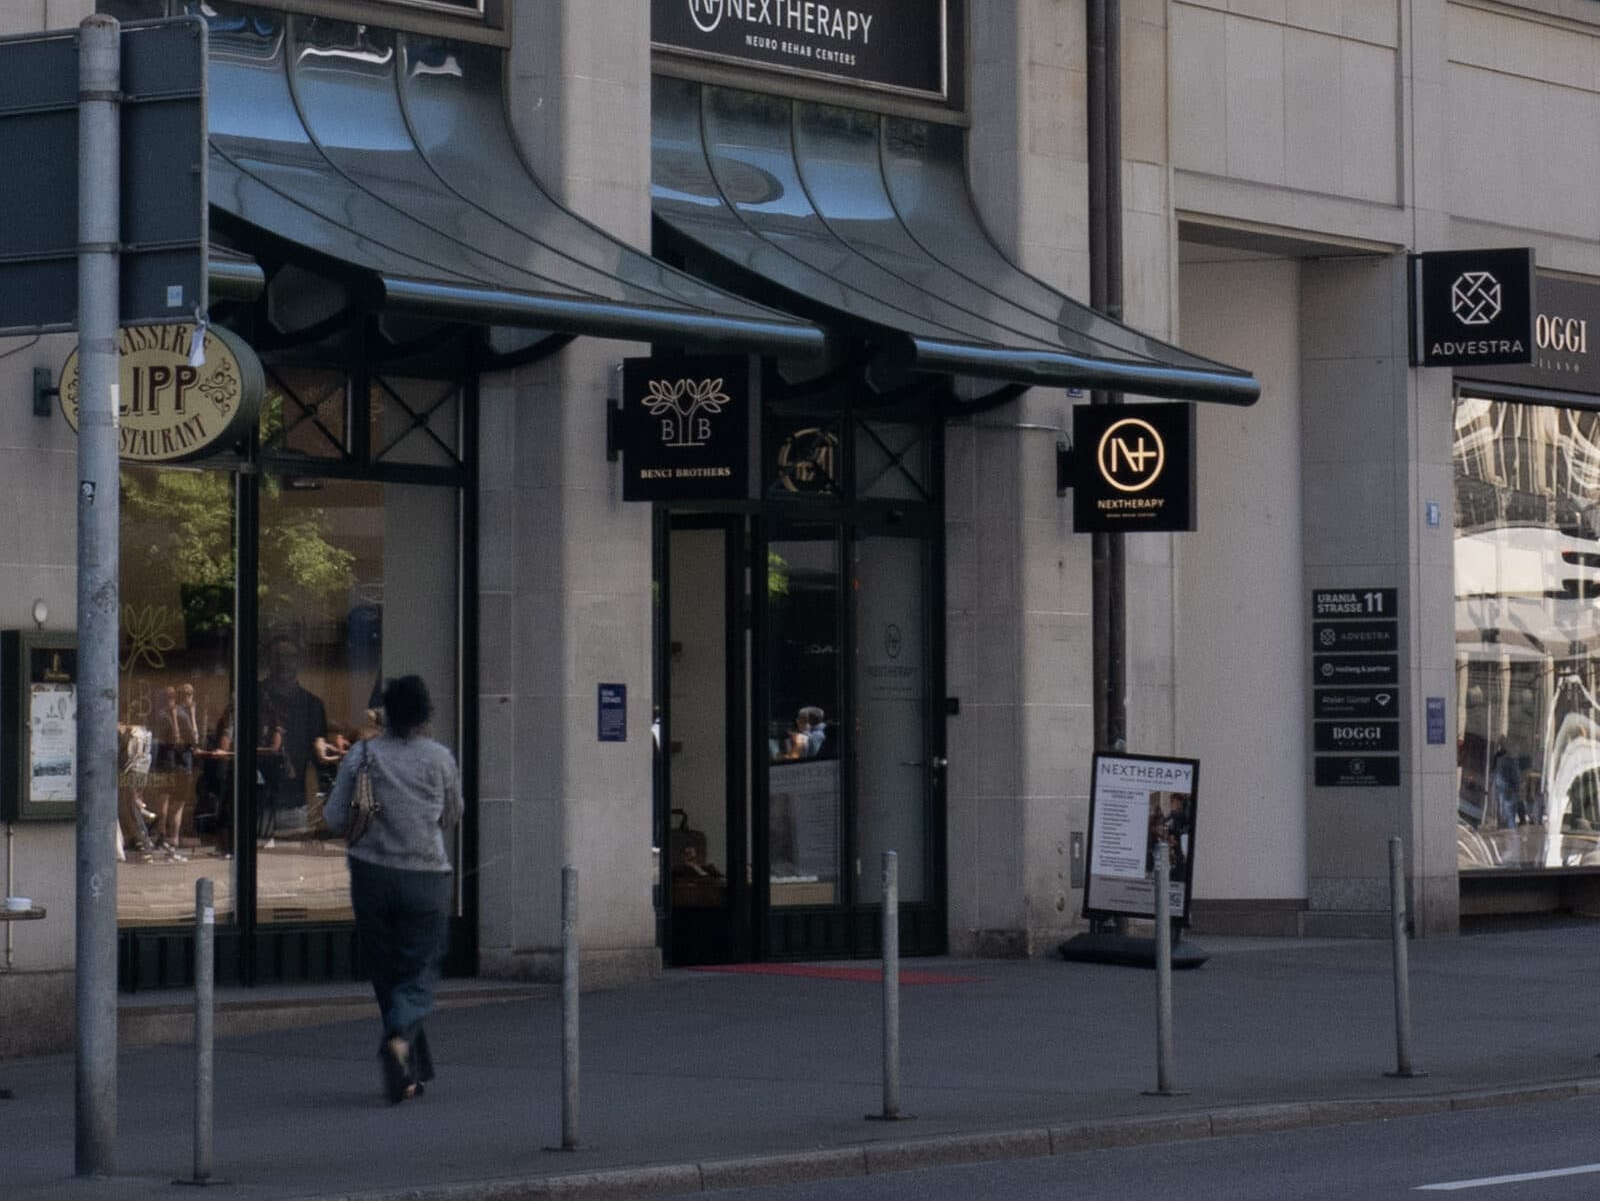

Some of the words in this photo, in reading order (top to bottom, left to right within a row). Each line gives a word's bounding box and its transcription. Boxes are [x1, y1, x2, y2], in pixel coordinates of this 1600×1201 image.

[745, 35, 778, 51] NEURO
[781, 41, 812, 57] REHAB
[815, 48, 856, 66] CENTERS
[1535, 313, 1587, 354] OGGI
[1431, 340, 1524, 356] ADVESTRA
[119, 413, 206, 456] STAURANT
[662, 419, 674, 440] B
[698, 418, 711, 439] B
[641, 469, 672, 478] BENCI
[676, 467, 730, 477] BROTHERS
[1098, 499, 1164, 509] NEXTHERAPY
[1317, 593, 1357, 603] URANIA
[1364, 592, 1383, 613] 11
[1317, 603, 1363, 613] STRASSE
[1333, 727, 1381, 740] BOGGI
[1101, 763, 1192, 782] NEXTHERAPY
